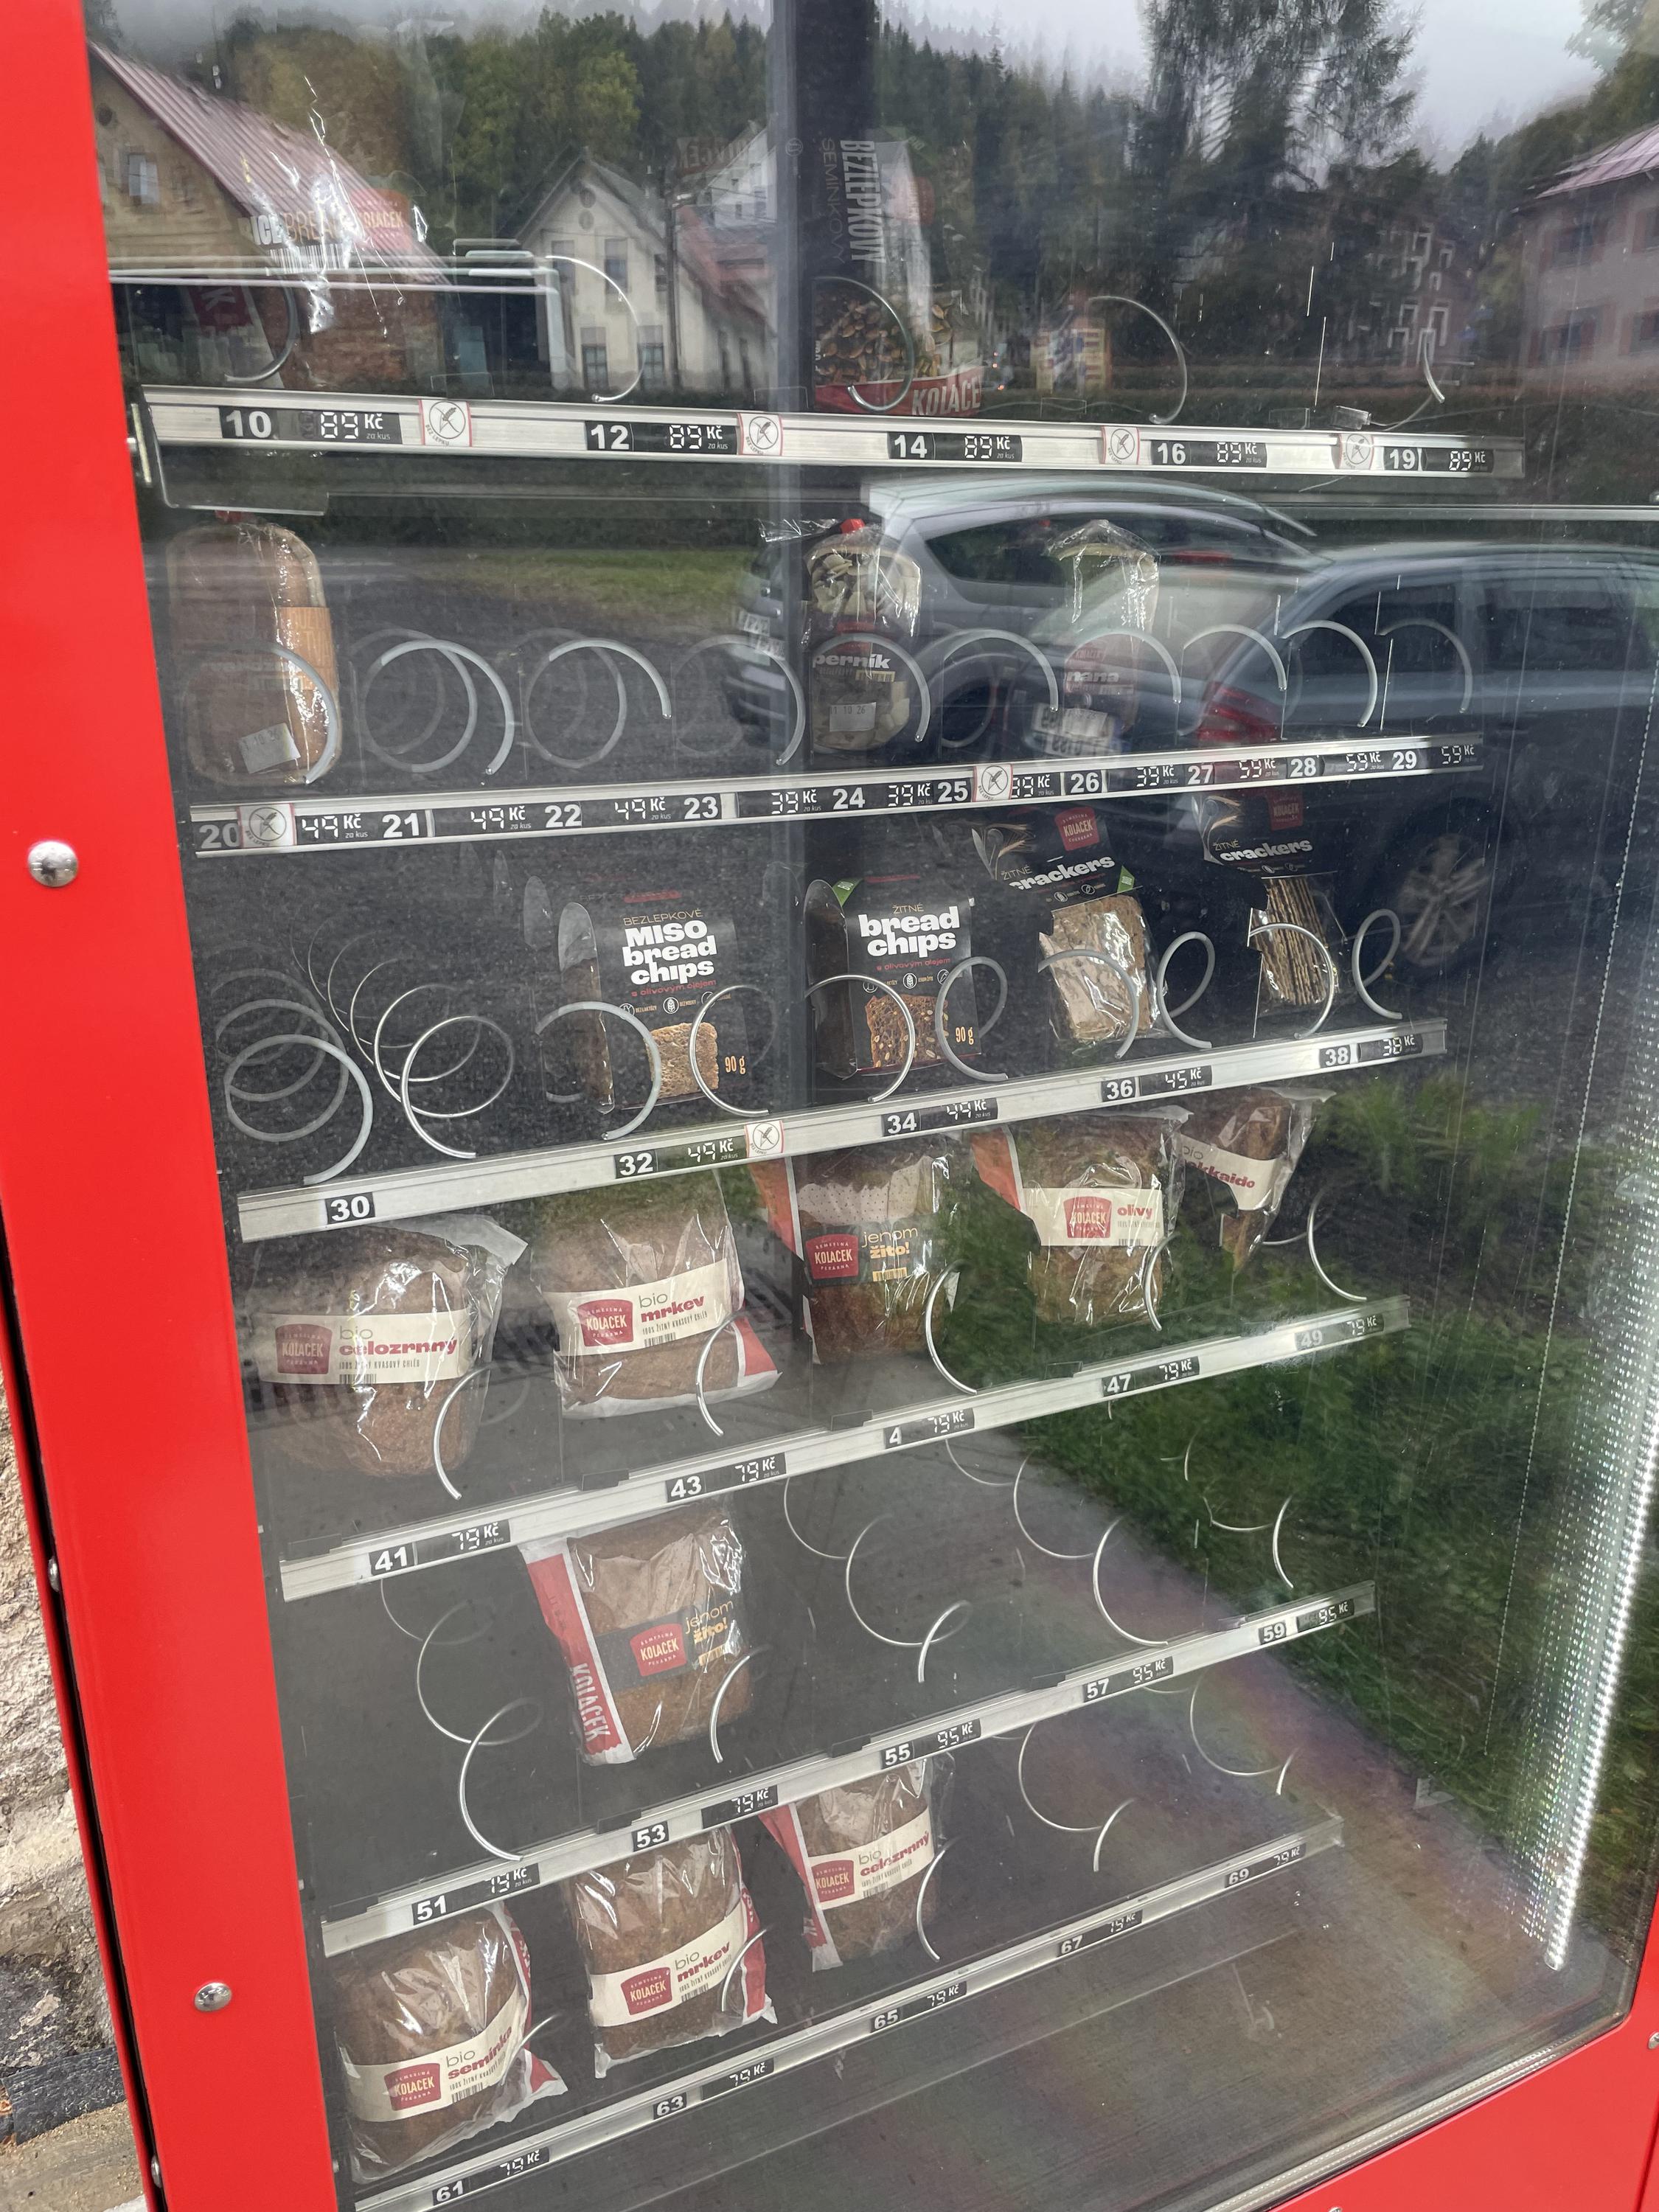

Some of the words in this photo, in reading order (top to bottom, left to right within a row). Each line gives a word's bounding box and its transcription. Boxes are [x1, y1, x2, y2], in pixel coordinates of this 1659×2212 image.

[226, 410, 272, 438] 10
[321, 411, 358, 439] 89
[364, 412, 383, 430] Kč
[377, 431, 391, 441] kus
[591, 424, 630, 450] 12
[669, 425, 702, 450] 89
[706, 425, 723, 440] Kč
[894, 434, 928, 459] 14
[964, 435, 992, 459] 89
[996, 437, 1011, 450] Kč
[1157, 442, 1186, 465] 16
[1217, 442, 1242, 463] 89
[1245, 442, 1257, 456] Kč
[1389, 448, 1416, 470] 19
[1448, 451, 1472, 471] 89
[844, 705, 852, 714] 10
[857, 704, 866, 714] 26
[1346, 754, 1369, 772] 59
[1370, 752, 1381, 763] Kč
[1392, 751, 1417, 770] 29
[1440, 745, 1462, 765] 59
[1464, 745, 1475, 756] Kč
[1136, 767, 1159, 787] 39
[1163, 765, 1175, 777] Kč
[1187, 765, 1214, 785] 27
[1238, 759, 1263, 779] 59
[1264, 759, 1276, 770] Kč
[1290, 757, 1317, 777] 28
[937, 781, 969, 803] 25
[1011, 776, 1034, 799] 39
[1037, 774, 1051, 788] Kč
[1070, 772, 1100, 794] 26
[771, 791, 799, 815] 39
[803, 789, 817, 804] Kč
[832, 787, 866, 810] 24
[888, 784, 914, 807] 39
[917, 782, 931, 797] Kč
[470, 807, 505, 830] 49
[509, 805, 526, 821] Kč
[544, 804, 582, 829] 22
[614, 799, 646, 820] 49
[650, 796, 666, 811] Kč
[684, 796, 719, 820] 23
[199, 823, 240, 848] 20
[302, 815, 338, 839] 49
[344, 813, 362, 830] Kč
[382, 813, 420, 838] 21
[519, 821, 532, 830] kus
[1212, 838, 1241, 851] ŽITNÉ
[1220, 839, 1313, 861] crackers
[1001, 864, 1033, 880] ŽITNÉ
[1009, 856, 1116, 891] crackers
[623, 908, 704, 926] BEZLEPKOVÉ
[892, 902, 925, 914] ŽITNÉ
[858, 906, 960, 937] bread
[625, 919, 708, 947] MISO
[622, 935, 717, 967] bread
[867, 932, 956, 958] chips
[630, 960, 714, 985] chips
[640, 983, 685, 995] olivovým
[956, 1026, 966, 1043] 90
[968, 1026, 974, 1045] g
[1404, 1034, 1415, 1046] Kč
[725, 1055, 737, 1073] 90
[740, 1055, 746, 1074] g
[1325, 1047, 1349, 1066] 38
[1107, 1079, 1133, 1099] 36
[1165, 1070, 1188, 1088] 45
[1190, 1068, 1202, 1079] Kč
[974, 1099, 987, 1112] Kč
[887, 1112, 917, 1135] 34
[687, 1142, 715, 1163] 49
[719, 1138, 734, 1153] Kč
[619, 1152, 653, 1176] 32
[331, 1195, 370, 1221] 30
[1117, 1203, 1153, 1220] olivy
[862, 1226, 918, 1248] jenom
[870, 1242, 910, 1259] žito!
[639, 1292, 669, 1309] bio
[641, 1295, 705, 1323] mrkev
[340, 1326, 373, 1340] bio
[1346, 1318, 1364, 1336] 79
[1367, 1315, 1377, 1327] Kč
[339, 1337, 457, 1356] celozrnný
[1301, 1329, 1323, 1347] 49
[374, 1358, 401, 1369] KVASOVÝ
[403, 1358, 420, 1368] CHLÉB
[1159, 1362, 1179, 1380] 79
[1181, 1359, 1192, 1371] Kč
[1107, 1374, 1131, 1394] 47
[927, 1414, 950, 1433] 79
[953, 1410, 964, 1423] Kč
[734, 1461, 759, 1482] 79
[762, 1456, 776, 1471] Kč
[670, 1475, 701, 1498] 43
[451, 1528, 479, 1550] 79
[484, 1522, 499, 1538] Kč
[375, 1546, 407, 1571] 41
[686, 1600, 734, 1635] jenom
[1318, 1607, 1337, 1625] 95
[1338, 1601, 1349, 1614] Kč
[1263, 1623, 1285, 1642] 59
[1133, 1663, 1153, 1683] 95
[1155, 1658, 1166, 1672] Kč
[1087, 1677, 1110, 1699] 57
[937, 1727, 959, 1749] 95
[961, 1721, 973, 1736] Kč
[885, 1743, 911, 1766] 55
[731, 1793, 754, 1813] 79
[757, 1787, 769, 1801] Kč
[636, 1823, 666, 1848] 53
[858, 1849, 882, 1865] bio
[1273, 1851, 1290, 1866] 79
[1291, 1846, 1300, 1858] Kč
[485, 1873, 510, 1893] 79
[513, 1866, 527, 1881] Kč
[1228, 1868, 1249, 1885] 69
[417, 1894, 447, 1921] 51
[1061, 1934, 1083, 1954] 67
[675, 1952, 700, 1971] bio
[678, 1941, 730, 1983] mrkev
[927, 1990, 946, 2006] 79
[948, 1984, 959, 1997] Kč
[874, 2008, 898, 2030] 65
[446, 2049, 476, 2068] bio
[729, 2069, 751, 2087] 79
[754, 2062, 765, 2076] Kč
[656, 2096, 684, 2116] 63
[500, 2157, 524, 2176] 79
[527, 2149, 540, 2165] Kč
[437, 2180, 464, 2202] 61
